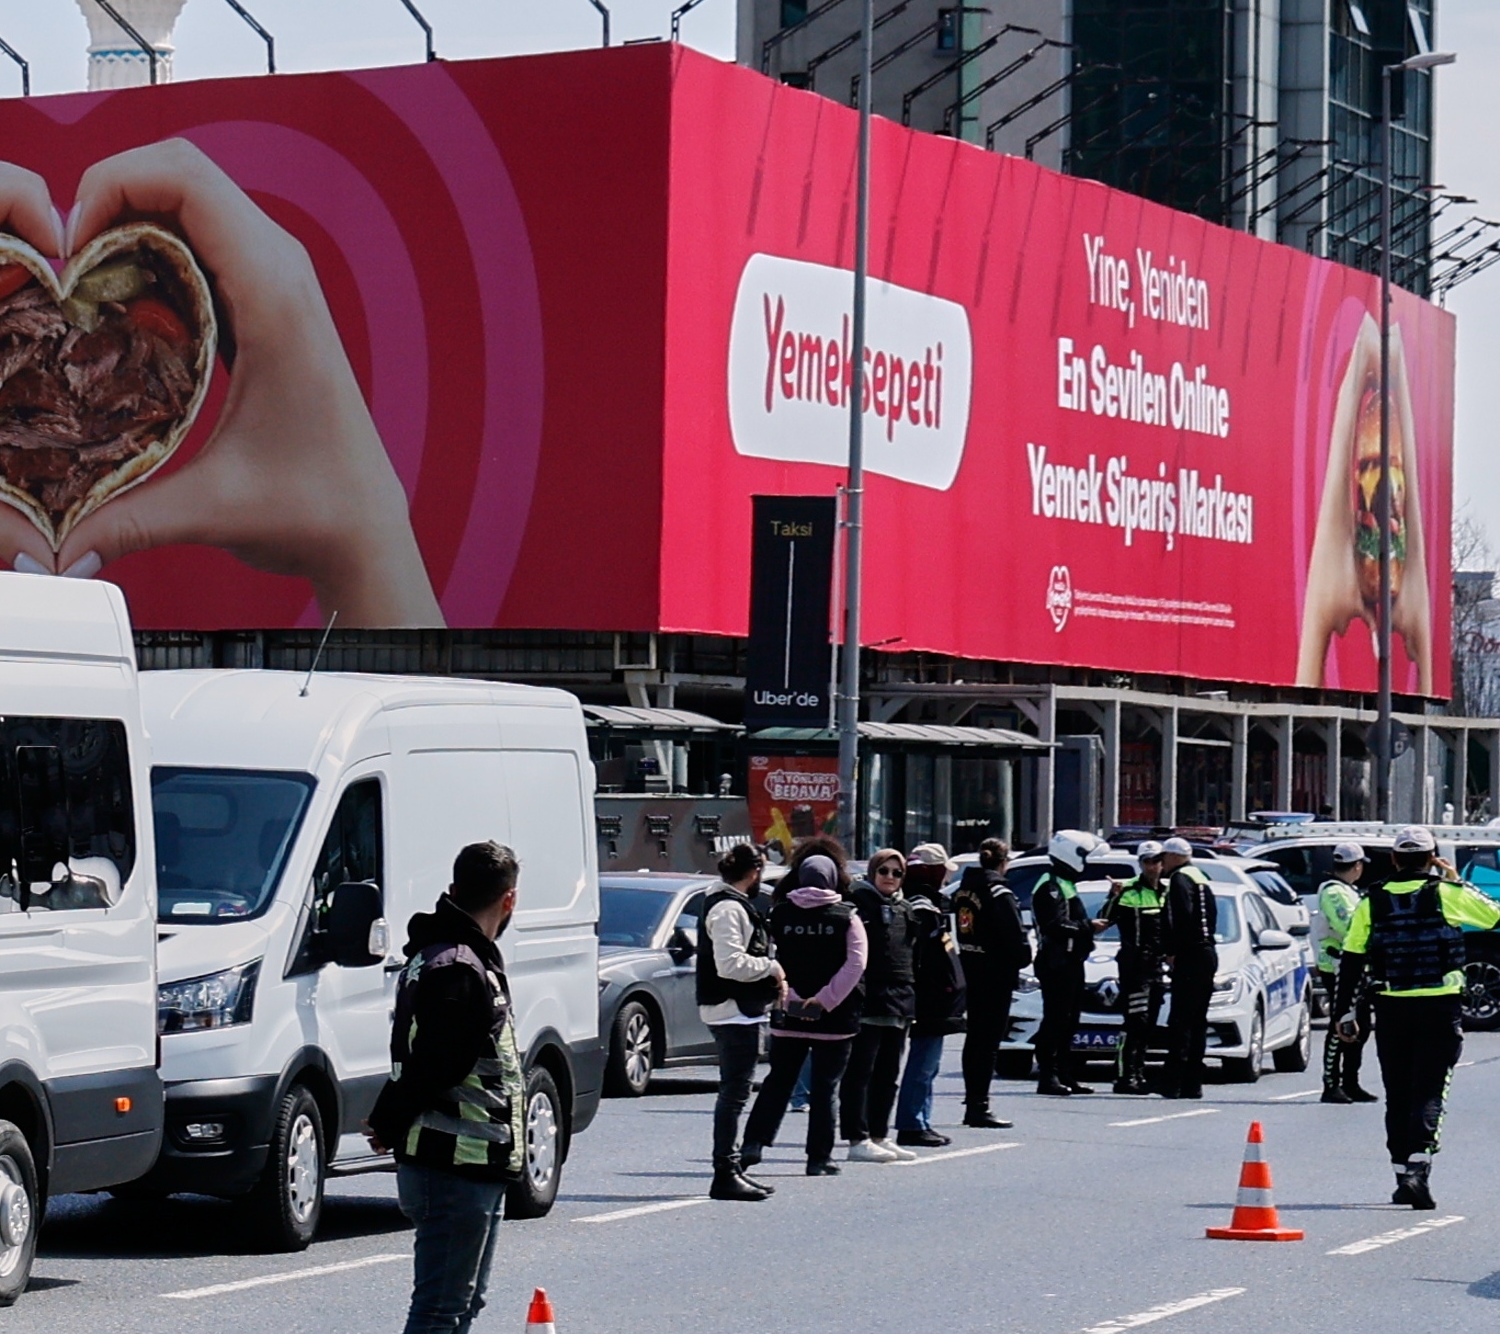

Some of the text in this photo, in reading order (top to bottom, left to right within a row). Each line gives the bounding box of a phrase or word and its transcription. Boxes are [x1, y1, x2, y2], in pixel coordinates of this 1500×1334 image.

[1083, 233, 1209, 331] Yine, Yeniden
[1057, 337, 1230, 438] En Sevilen Online
[1026, 442, 1253, 552] Yemek Sipariş Markası
[771, 520, 813, 537] Taksi
[754, 690, 819, 707] Uber'de
[774, 784, 831, 798] BEDAVA
[784, 923, 835, 935] POLİS
[1073, 1033, 1088, 1045] 34
[1092, 1033, 1104, 1045] A
